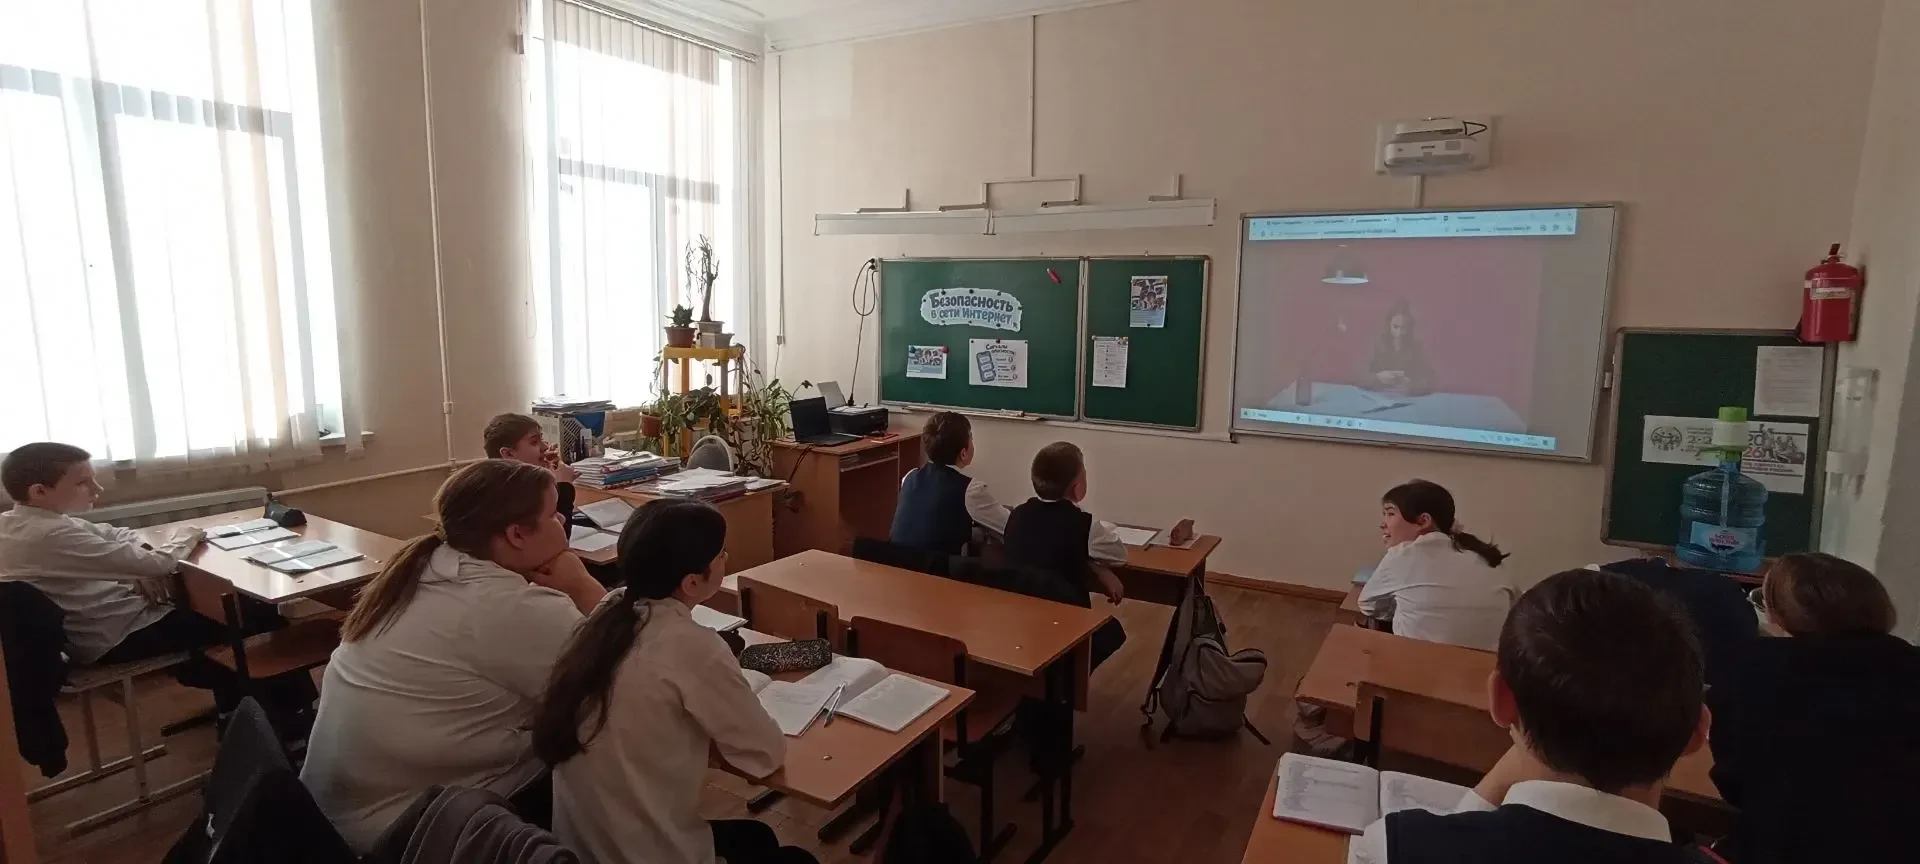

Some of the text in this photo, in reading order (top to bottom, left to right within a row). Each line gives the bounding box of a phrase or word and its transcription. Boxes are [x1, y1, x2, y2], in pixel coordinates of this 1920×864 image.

[929, 292, 1014, 312] Безопасность
[939, 308, 960, 319] сети
[962, 308, 1013, 324] Интернет
